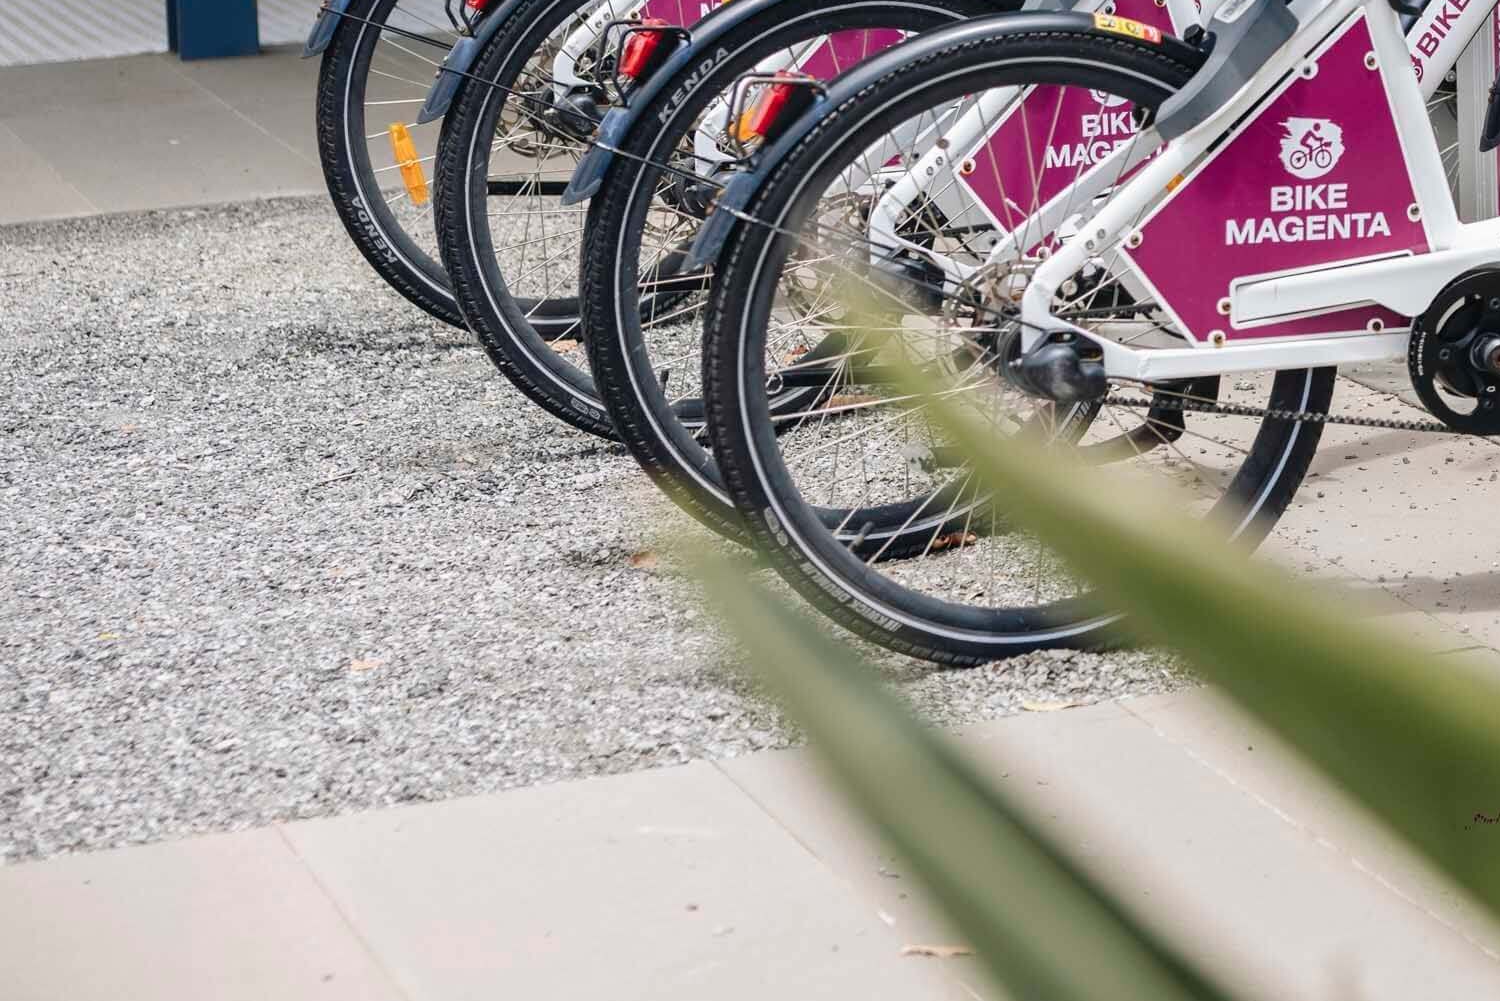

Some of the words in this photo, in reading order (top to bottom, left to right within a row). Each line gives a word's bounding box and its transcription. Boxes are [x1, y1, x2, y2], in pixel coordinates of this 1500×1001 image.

[658, 47, 729, 124] KENDA
[1270, 183, 1348, 212] BIKE
[352, 196, 398, 263] KENDA
[1224, 212, 1392, 246] MAGENTA
